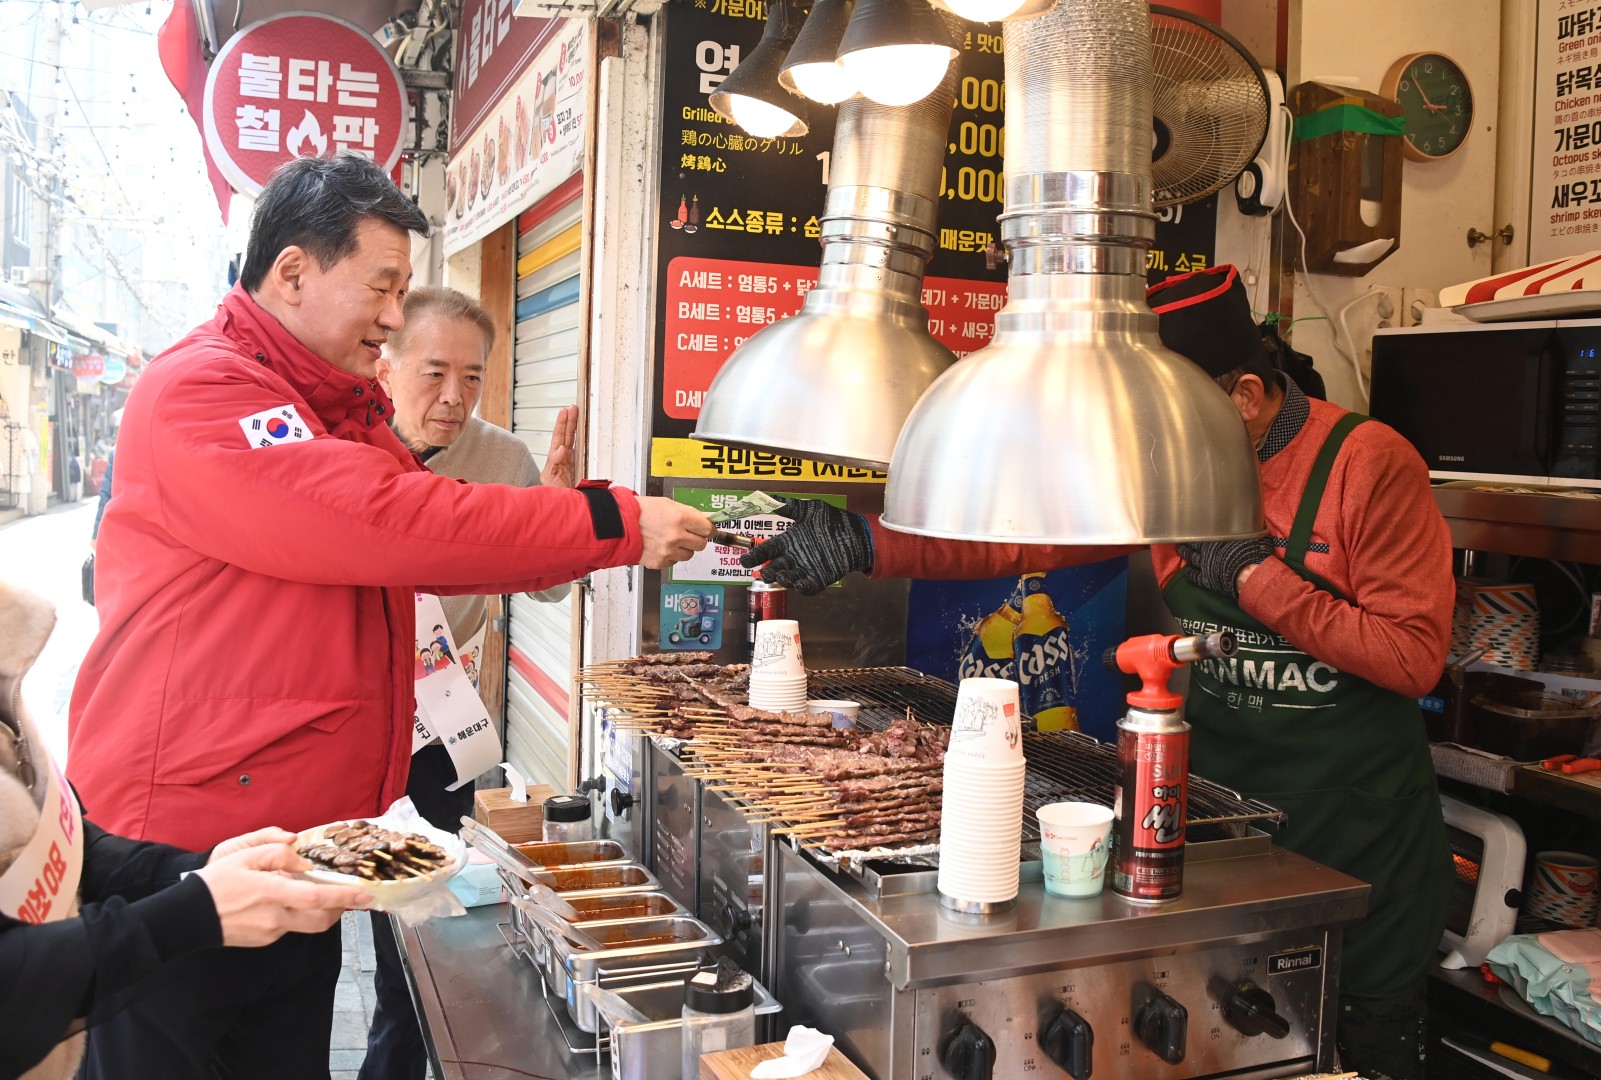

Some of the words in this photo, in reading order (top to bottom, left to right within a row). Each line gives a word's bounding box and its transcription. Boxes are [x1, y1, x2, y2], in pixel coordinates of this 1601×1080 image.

[711, 0, 769, 20] 가문어
[1559, 38, 1585, 53] Green
[1424, 62, 1433, 74] 12
[238, 53, 380, 108] 불타는
[1450, 84, 1458, 96] 2
[1455, 105, 1462, 116] 3
[1555, 96, 1590, 112] Chicken
[1593, 93, 1601, 103] n
[1450, 125, 1456, 134] 4
[1423, 142, 1431, 152] 6
[1438, 137, 1445, 148] 5
[1553, 152, 1589, 167] Octopus
[1550, 211, 1580, 224] shrimp
[1583, 208, 1601, 219] ske
[705, 206, 784, 236] 소스종류
[940, 228, 994, 254] 매운맛
[1175, 252, 1207, 272] 소금
[679, 271, 722, 290] A세트
[737, 274, 778, 294] 염통5
[963, 292, 1008, 310] 가문어
[678, 302, 720, 320] B세트
[736, 305, 776, 324] 염통5
[677, 334, 718, 352] C세트
[701, 444, 802, 477] 국민은행
[744, 519, 773, 531] 이벤트
[1034, 666, 1061, 688] FRESH
[457, 718, 489, 741] 해운대구
[1277, 953, 1312, 970] Rinnai
